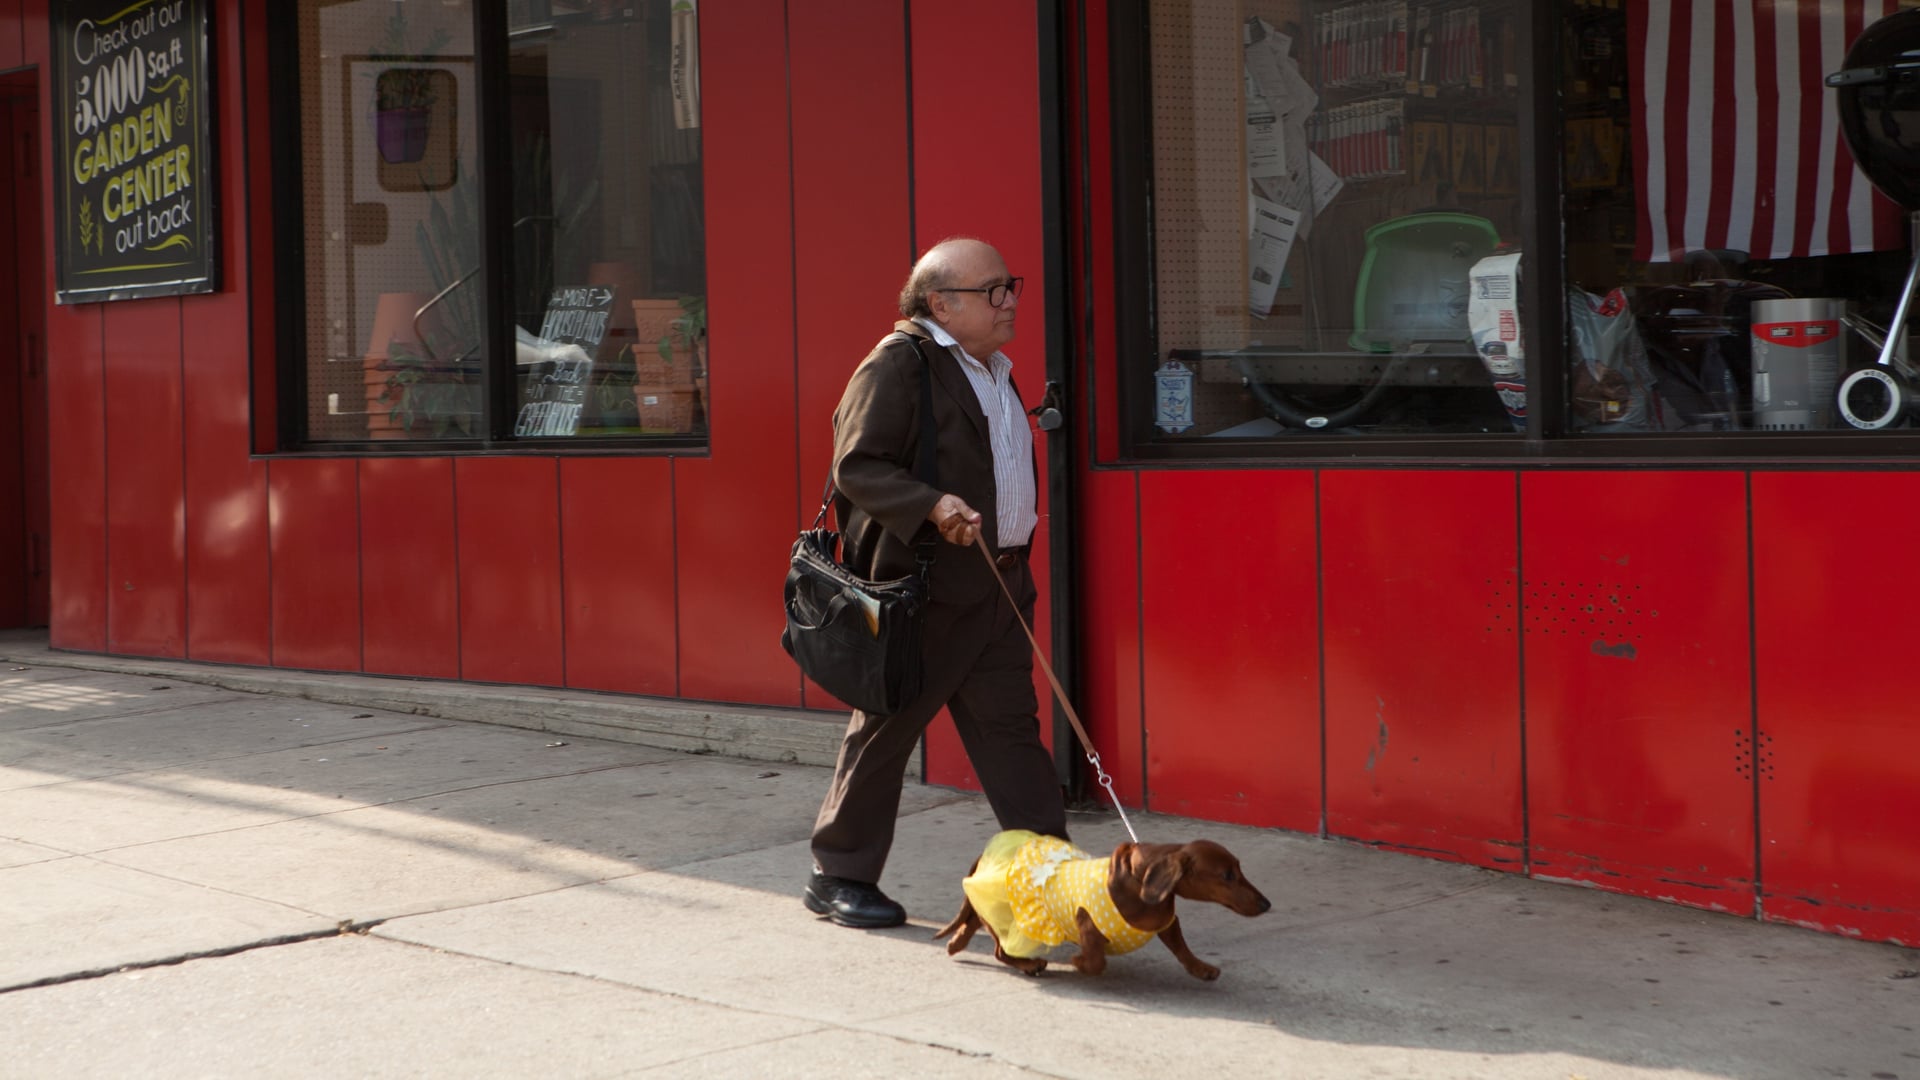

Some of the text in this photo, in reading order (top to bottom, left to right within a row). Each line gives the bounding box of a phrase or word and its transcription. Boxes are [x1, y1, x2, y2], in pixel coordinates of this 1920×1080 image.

[74, 0, 183, 65] Check out our
[74, 46, 146, 135] 5,000
[73, 97, 173, 184] GARDEN
[102, 144, 192, 223] CENTER
[115, 194, 192, 253] out back
[560, 288, 598, 307] MORE
